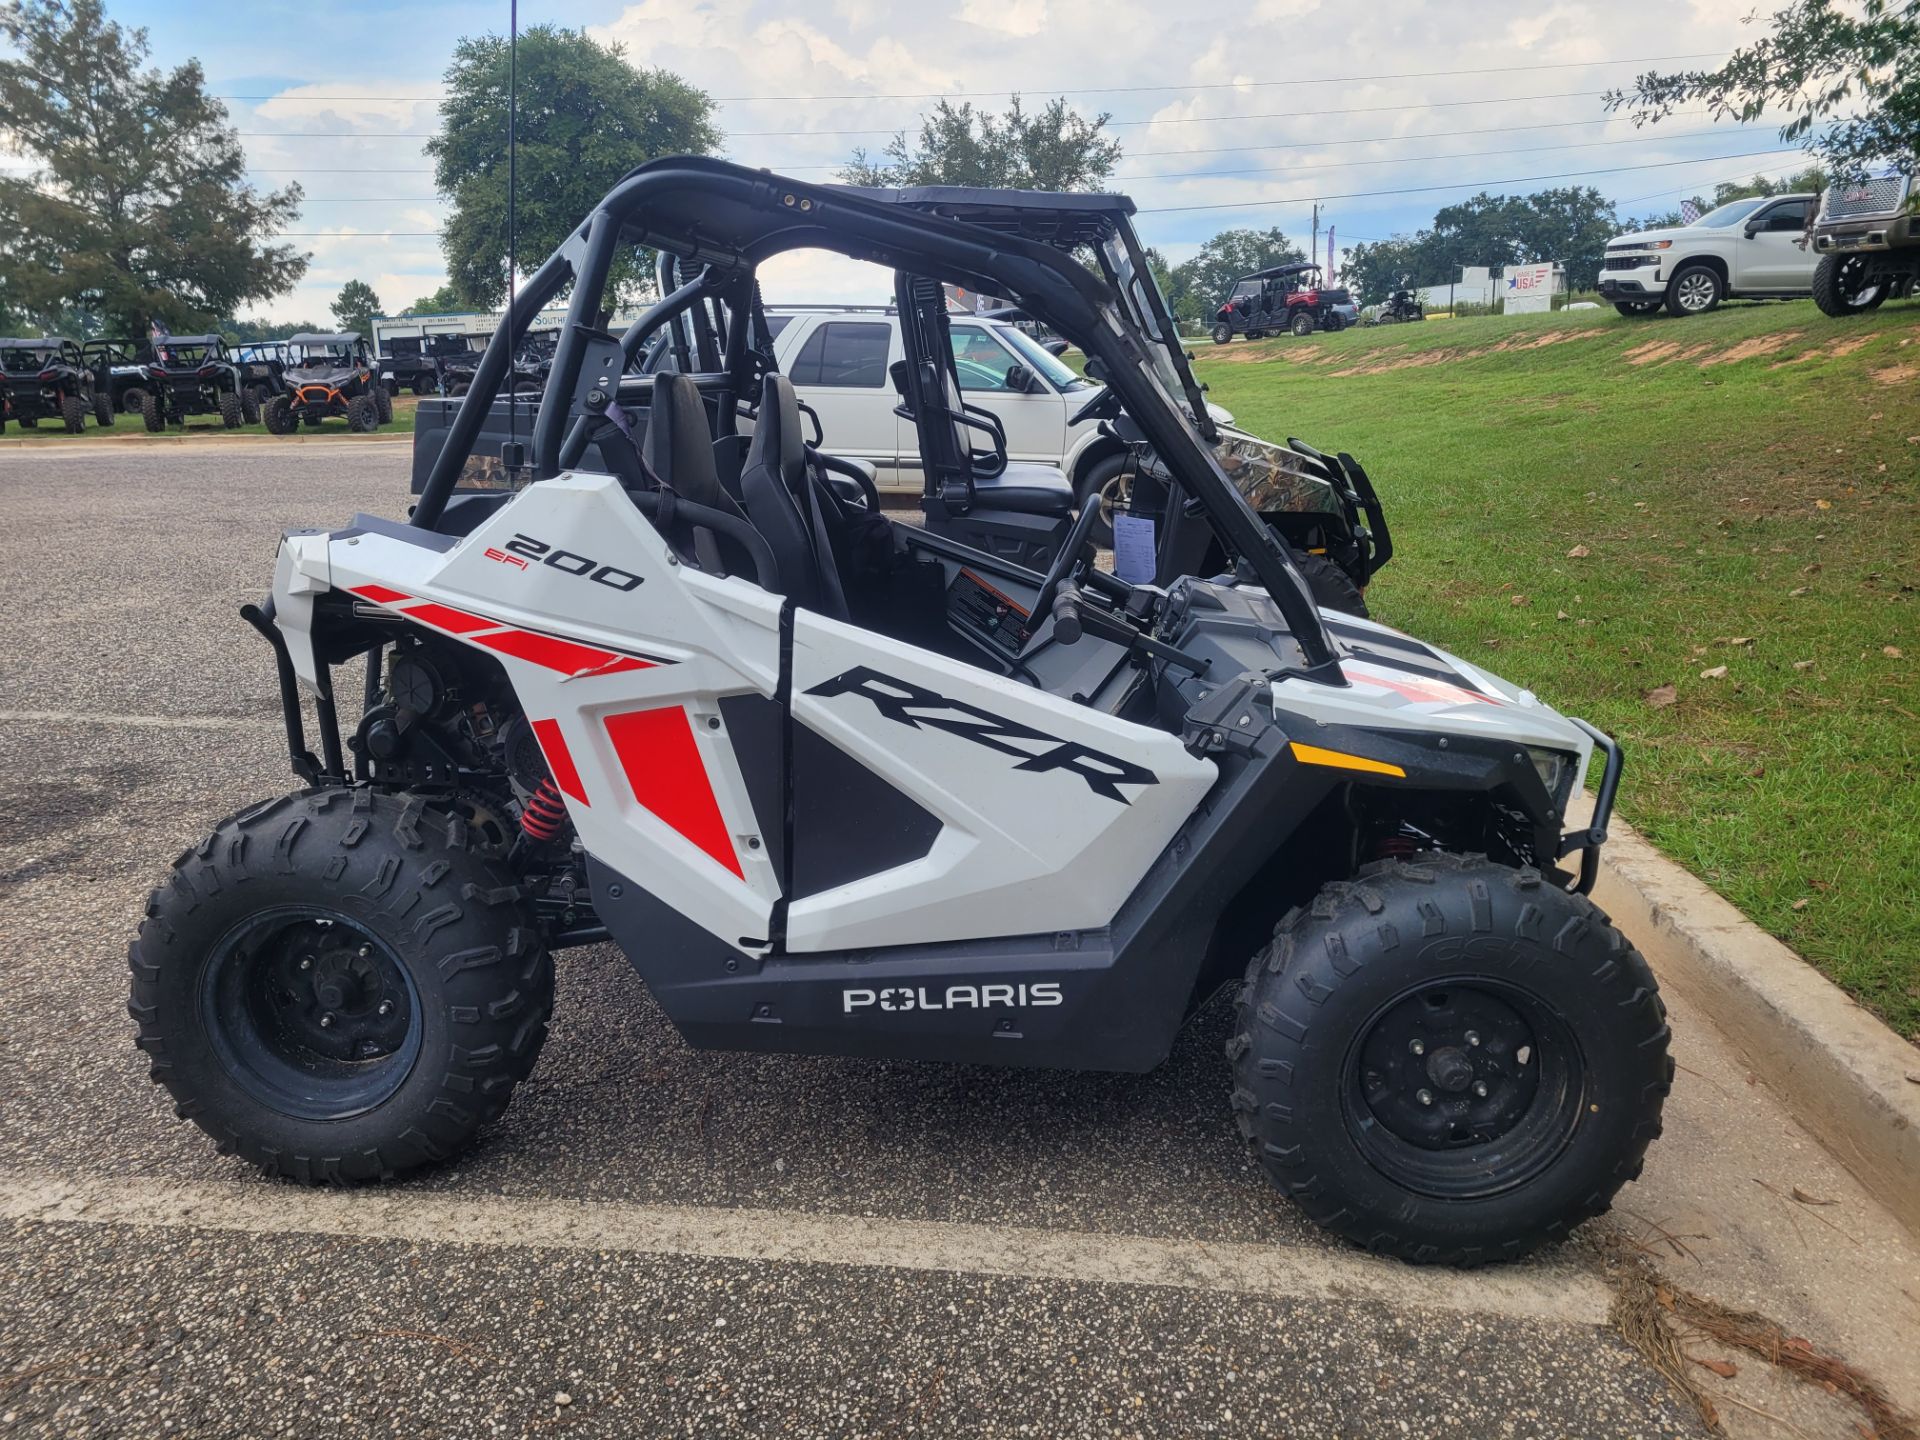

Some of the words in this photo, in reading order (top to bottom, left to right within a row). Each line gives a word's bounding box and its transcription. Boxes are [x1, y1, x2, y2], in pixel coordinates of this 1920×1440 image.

[1517, 277, 1534, 289] USA
[483, 547, 529, 571] EFI
[504, 532, 645, 592] 200
[801, 665, 1160, 806] RZR
[843, 983, 1064, 1013] POLARIS
